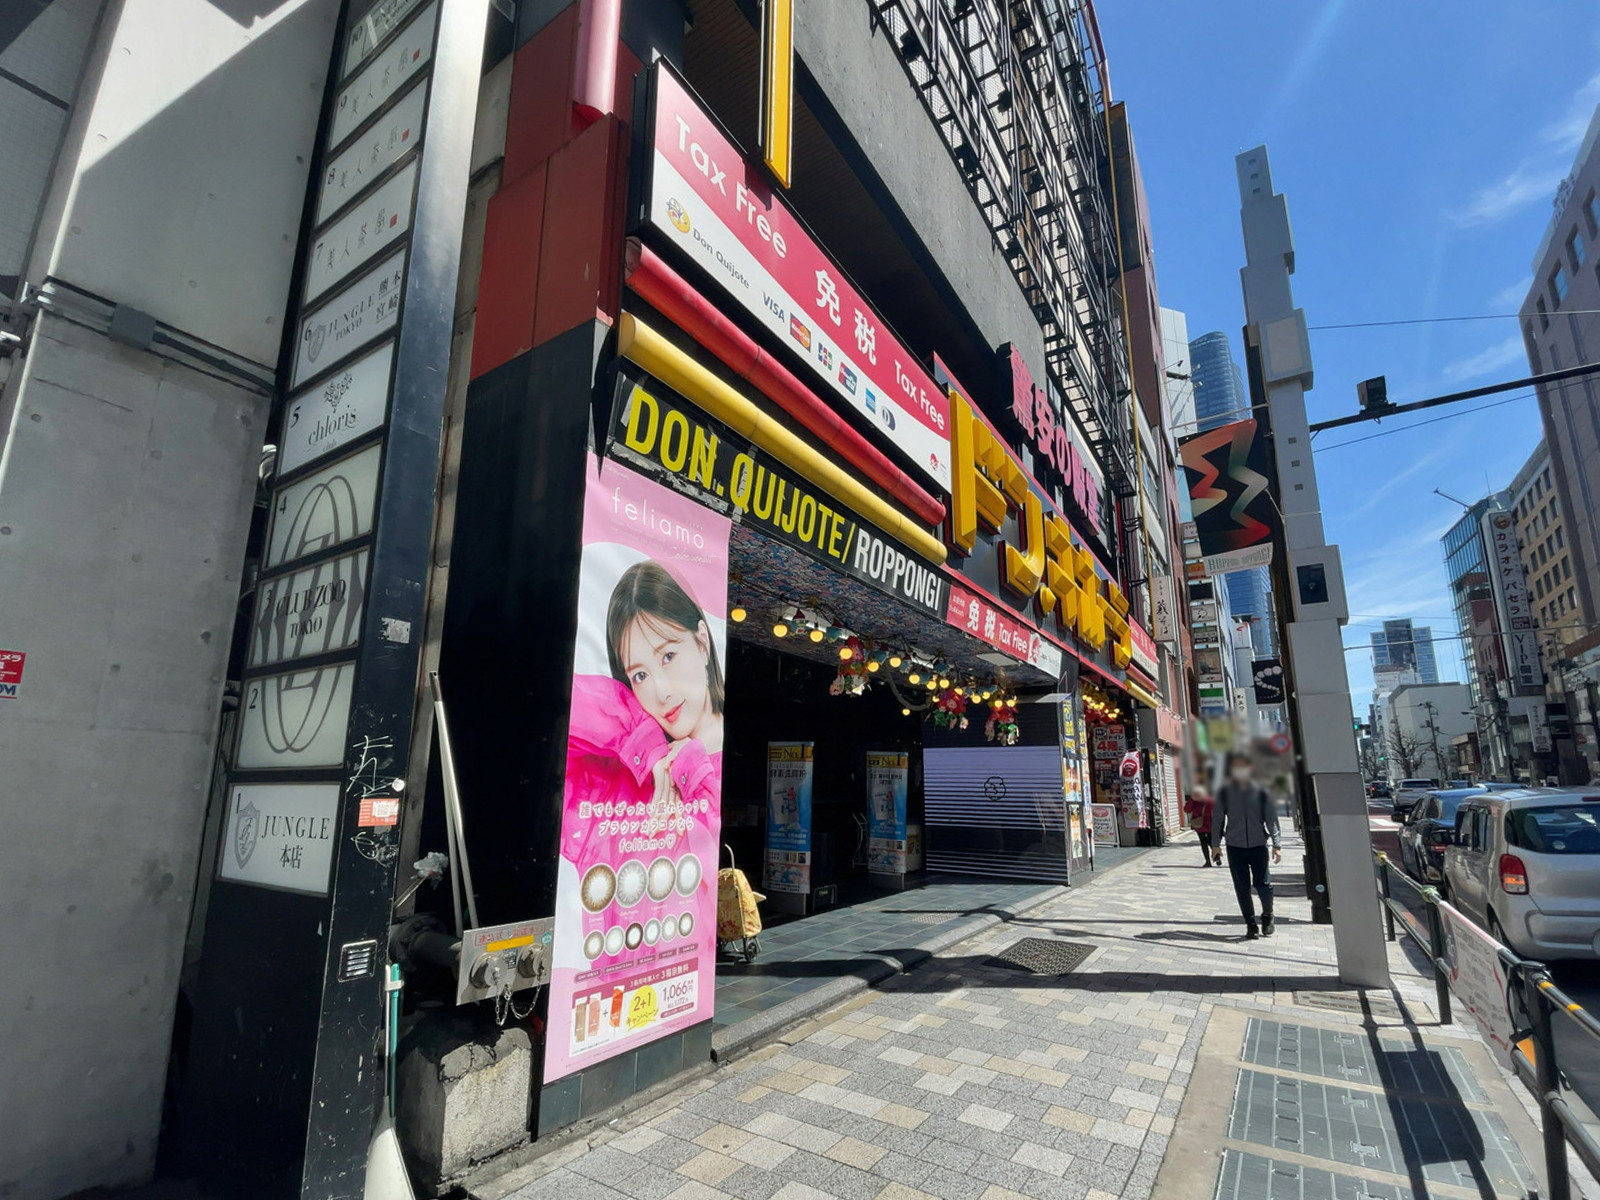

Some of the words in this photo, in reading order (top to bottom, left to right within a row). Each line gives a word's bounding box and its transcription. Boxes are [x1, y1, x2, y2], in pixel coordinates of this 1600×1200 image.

[341, 95, 348, 108] 9
[328, 168, 336, 185] 8
[675, 113, 727, 197] Tax
[735, 180, 787, 259] Free
[317, 243, 324, 261] 7
[693, 228, 713, 254] Don
[715, 250, 750, 288] Quijote
[327, 293, 375, 337] JUNGLE
[762, 291, 785, 323] VISA
[814, 268, 877, 366] 免税
[304, 321, 313, 342] 6
[336, 317, 362, 341] TOKYO
[894, 359, 918, 403] Tax
[920, 387, 945, 431] Free
[290, 406, 301, 428] 5
[308, 404, 357, 447] chloris
[279, 496, 288, 515] 4
[611, 486, 705, 550] feliamo
[263, 589, 273, 613] 3
[276, 587, 313, 617] CLUB
[313, 579, 346, 609] ZOO
[290, 616, 323, 639] TOKYO
[998, 622, 1011, 646] Tax
[1012, 631, 1028, 653] Free
[249, 688, 258, 709] 2
[236, 793, 242, 814] 1
[261, 815, 330, 840] JUNGLE
[599, 818, 695, 836] ブラウンカラコンなら
[280, 844, 304, 869] 本店
[619, 837, 666, 854] feliamo
[633, 992, 652, 1012] 2+1
